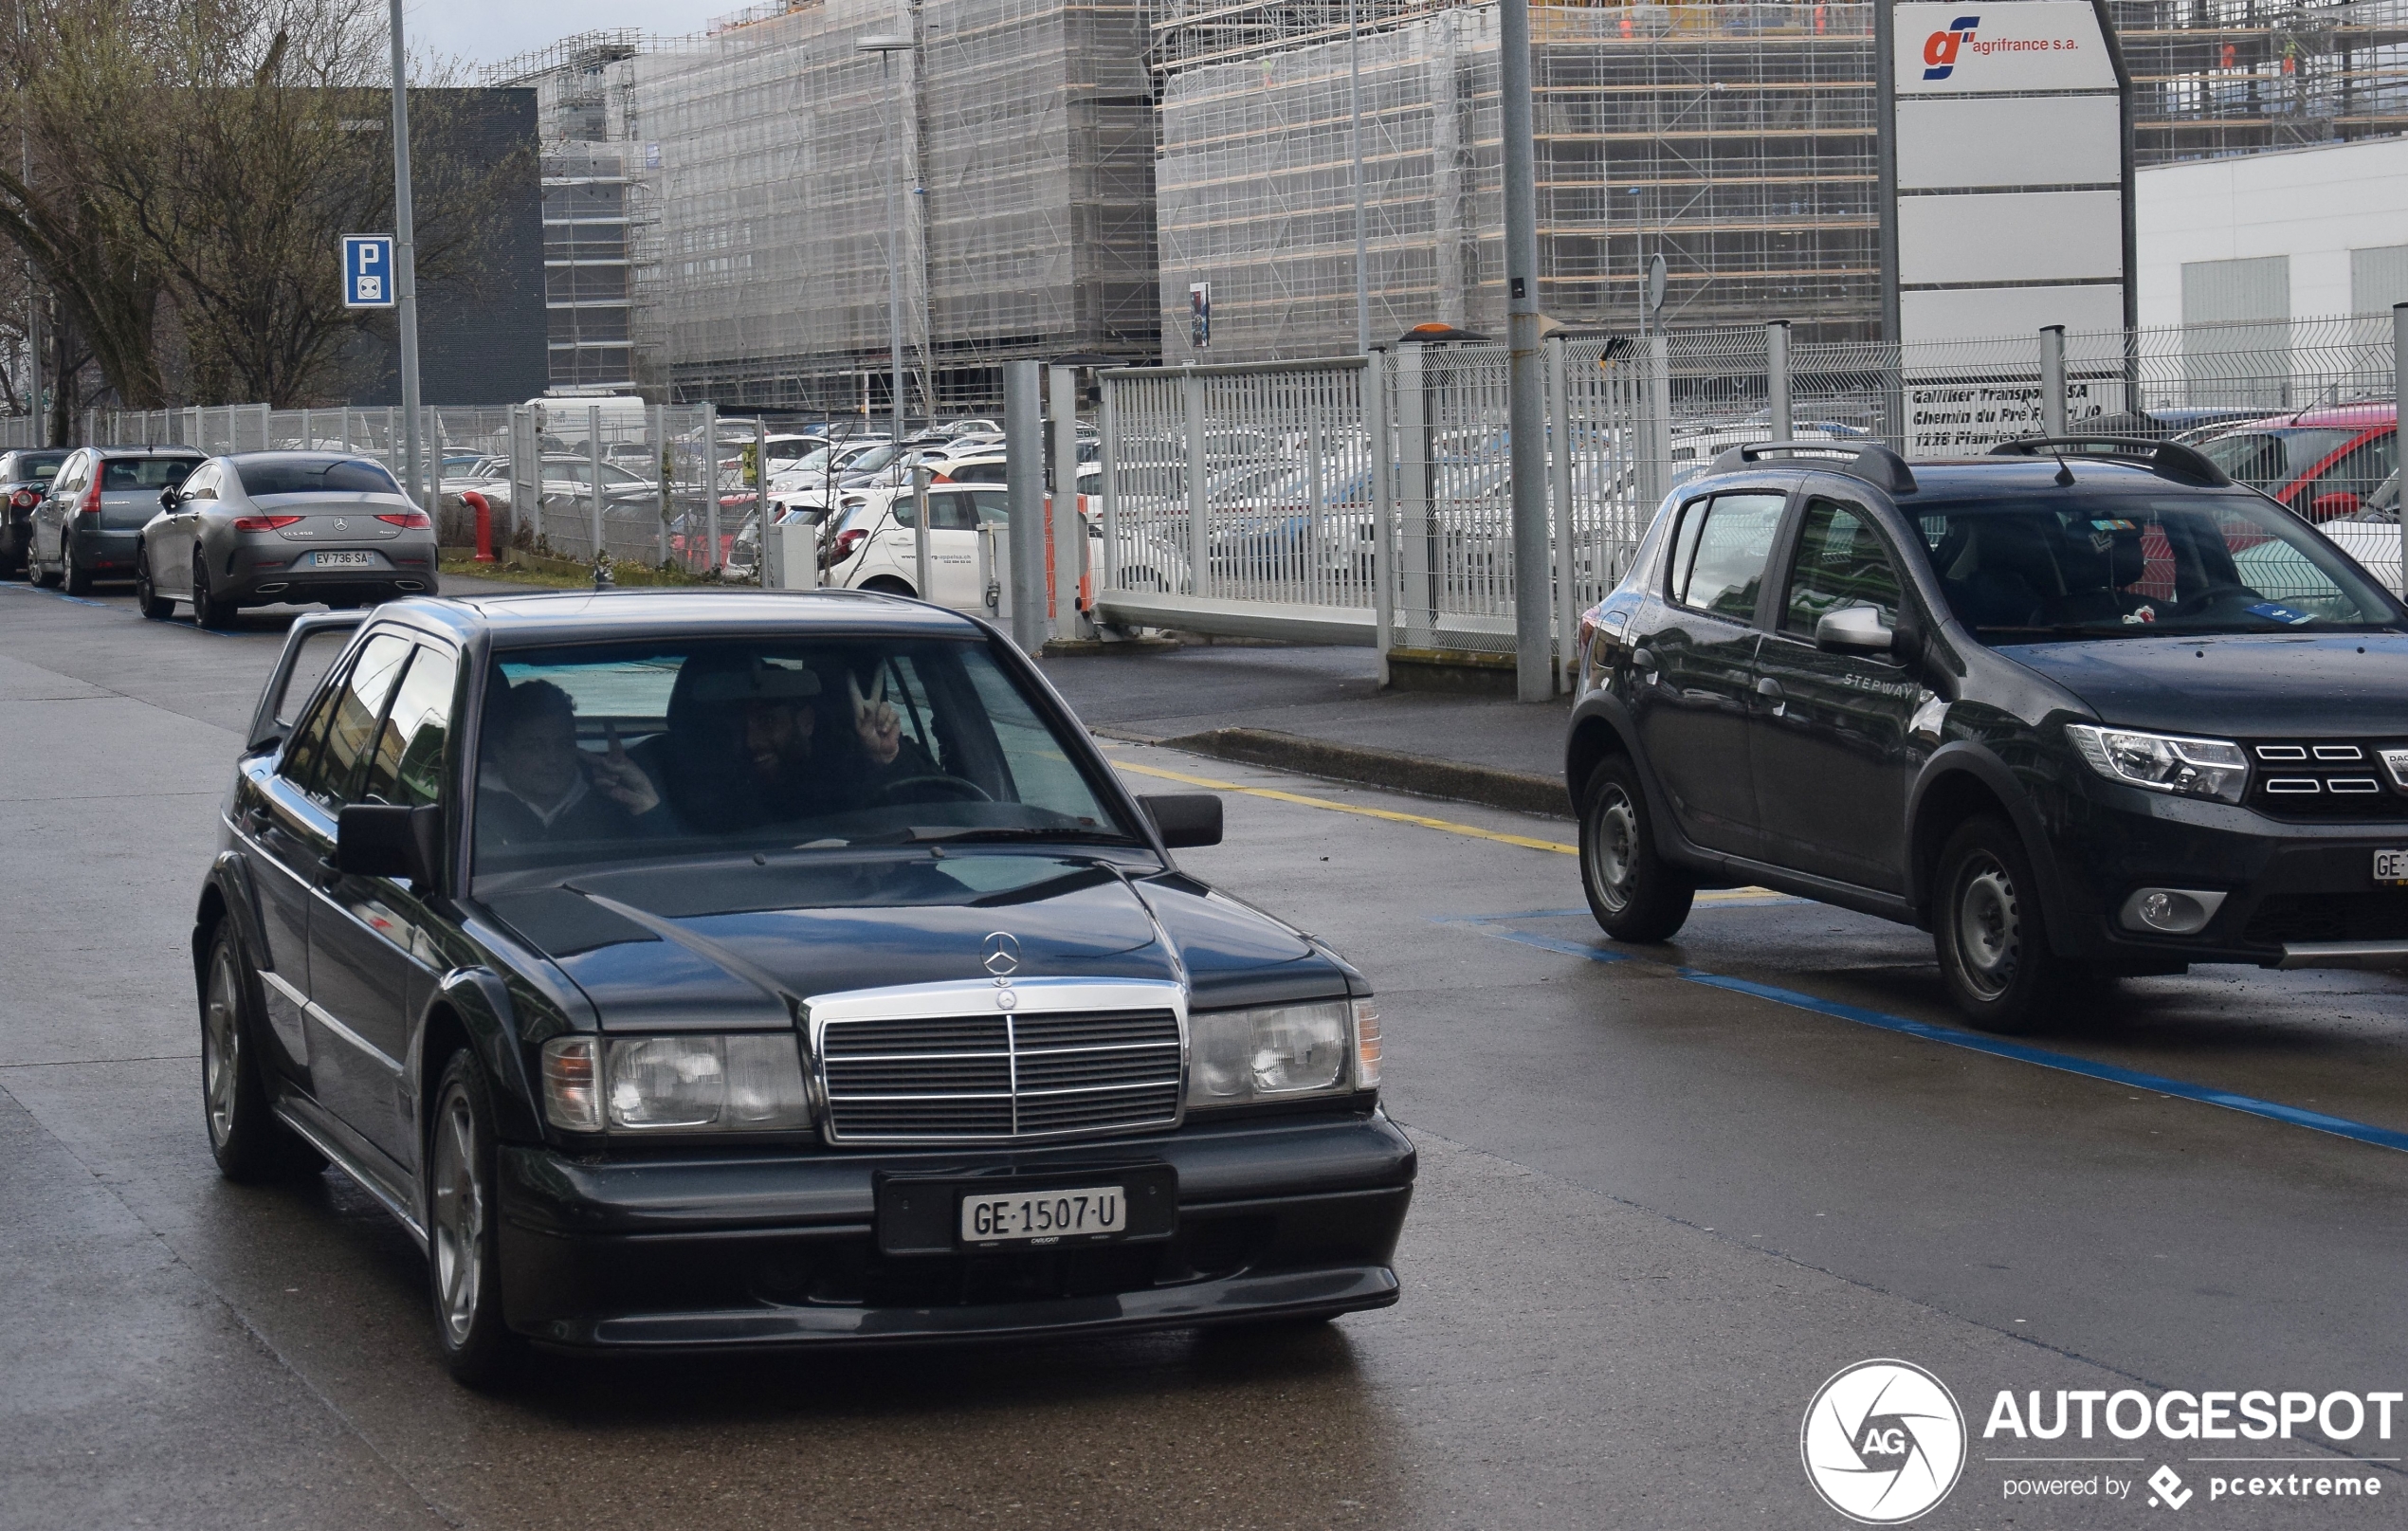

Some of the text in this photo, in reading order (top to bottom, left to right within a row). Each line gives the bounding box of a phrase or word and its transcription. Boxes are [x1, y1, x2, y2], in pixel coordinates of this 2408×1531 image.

[1973, 38, 2079, 55] agrifrance s.a.
[359, 244, 379, 274] P
[1912, 390, 1975, 404] Galliker
[1913, 410, 1971, 426] Chemin
[1975, 409, 1996, 423] du
[1998, 407, 2027, 423] Pré
[316, 553, 368, 564] EV-736-SA
[1844, 673, 1913, 700] STEPWAY
[2377, 854, 2408, 876] GE·
